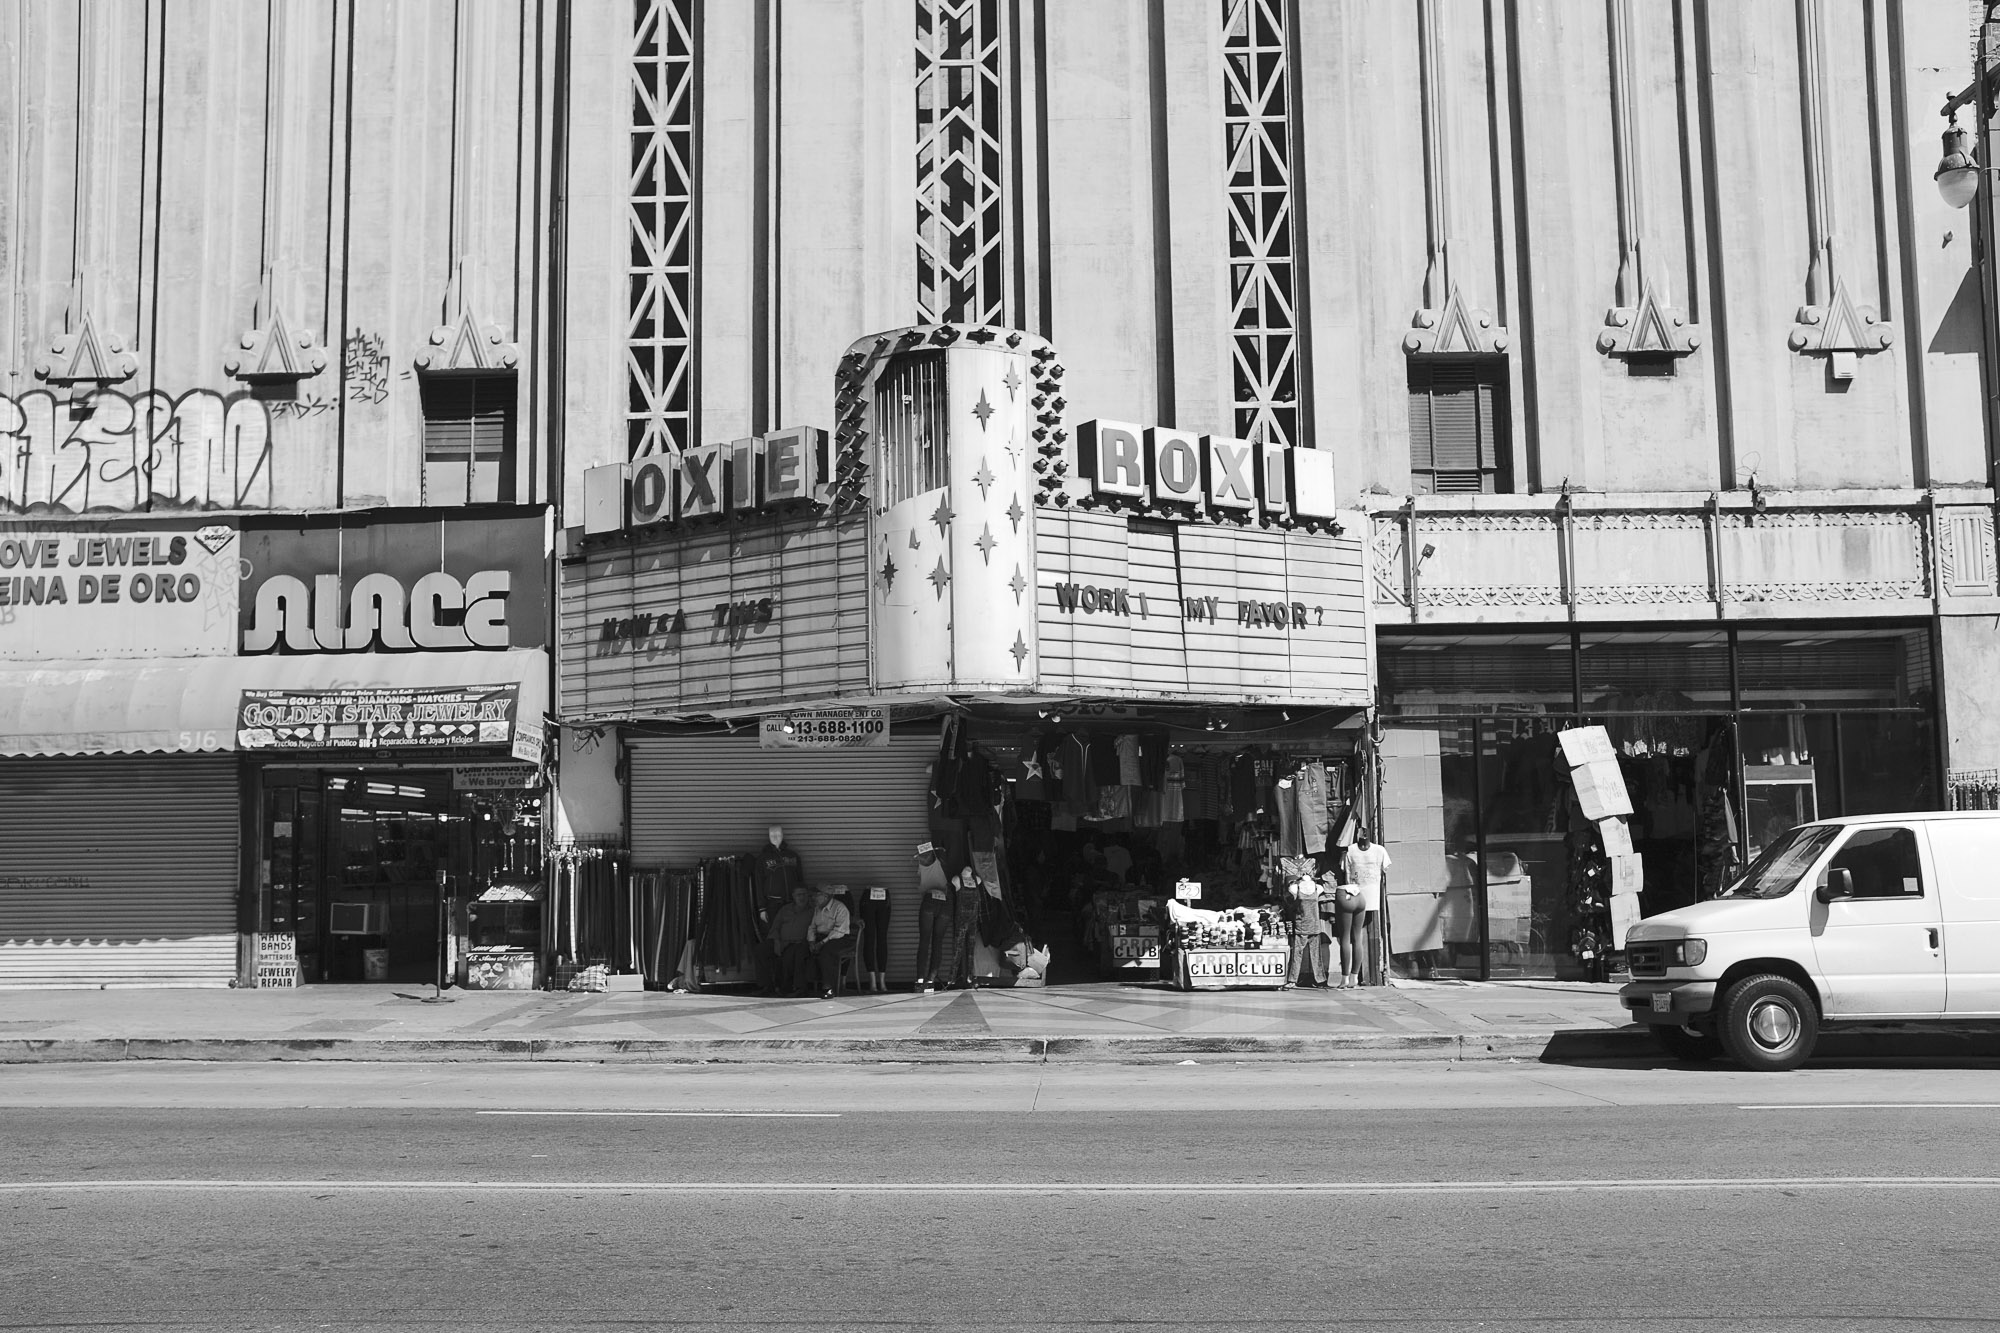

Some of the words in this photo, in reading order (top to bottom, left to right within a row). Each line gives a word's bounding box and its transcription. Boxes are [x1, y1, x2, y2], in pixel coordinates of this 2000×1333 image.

[1102, 427, 1285, 504] ROXI
[633, 435, 800, 521] OXIE
[68, 536, 187, 567] JEWELS
[78, 574, 121, 604] DE
[130, 573, 200, 604] ORO
[1056, 582, 1130, 617] WORK
[1187, 596, 1219, 625] MY
[715, 597, 774, 628] THIS
[243, 703, 338, 727] GOLDEN
[342, 704, 403, 724] STAR
[407, 699, 512, 722] JEWELRY
[766, 723, 783, 732] CALL
[179, 731, 217, 748] 516
[379, 737, 418, 747] Reparaciones
[419, 737, 427, 745] de
[428, 736, 446, 745] Joyas
[451, 736, 474, 745] Relojes
[468, 777, 484, 786] We
[487, 777, 506, 787] Buy
[261, 932, 293, 941] WATCH
[261, 942, 292, 950] BANDS
[1119, 938, 1153, 949] PRO
[1115, 946, 1157, 957] CLUB
[1195, 955, 1230, 965] PRO
[1244, 955, 1278, 965] PRO
[257, 967, 296, 977] JEWELRY
[1190, 964, 1234, 975] CLUB
[1239, 964, 1283, 975] CLUB
[261, 978, 292, 987] REPAIR
